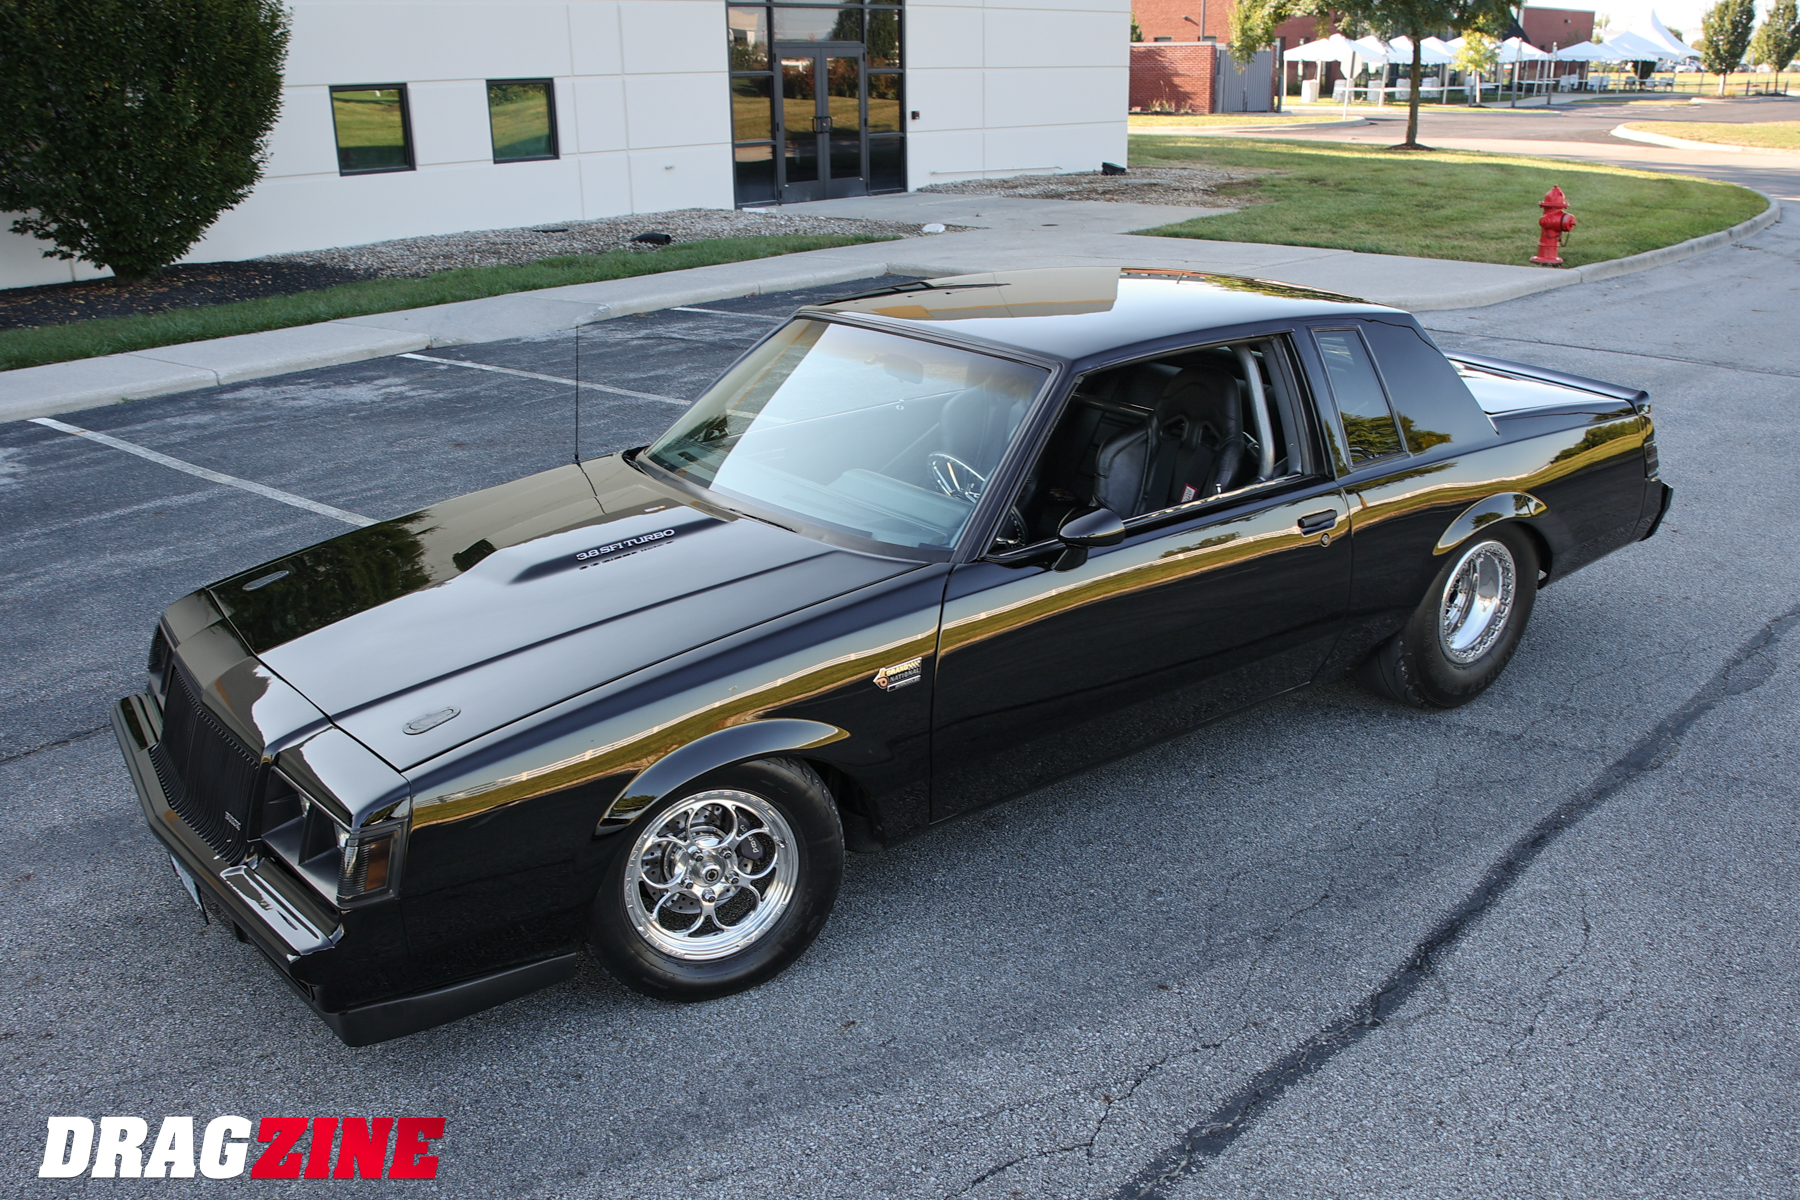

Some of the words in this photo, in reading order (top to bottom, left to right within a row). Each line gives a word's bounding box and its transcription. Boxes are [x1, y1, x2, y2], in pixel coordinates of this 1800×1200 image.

[600, 542, 624, 555] SFI
[623, 529, 676, 548] TURBO
[886, 663, 909, 677] GRAND
[739, 824, 760, 854] wwood
